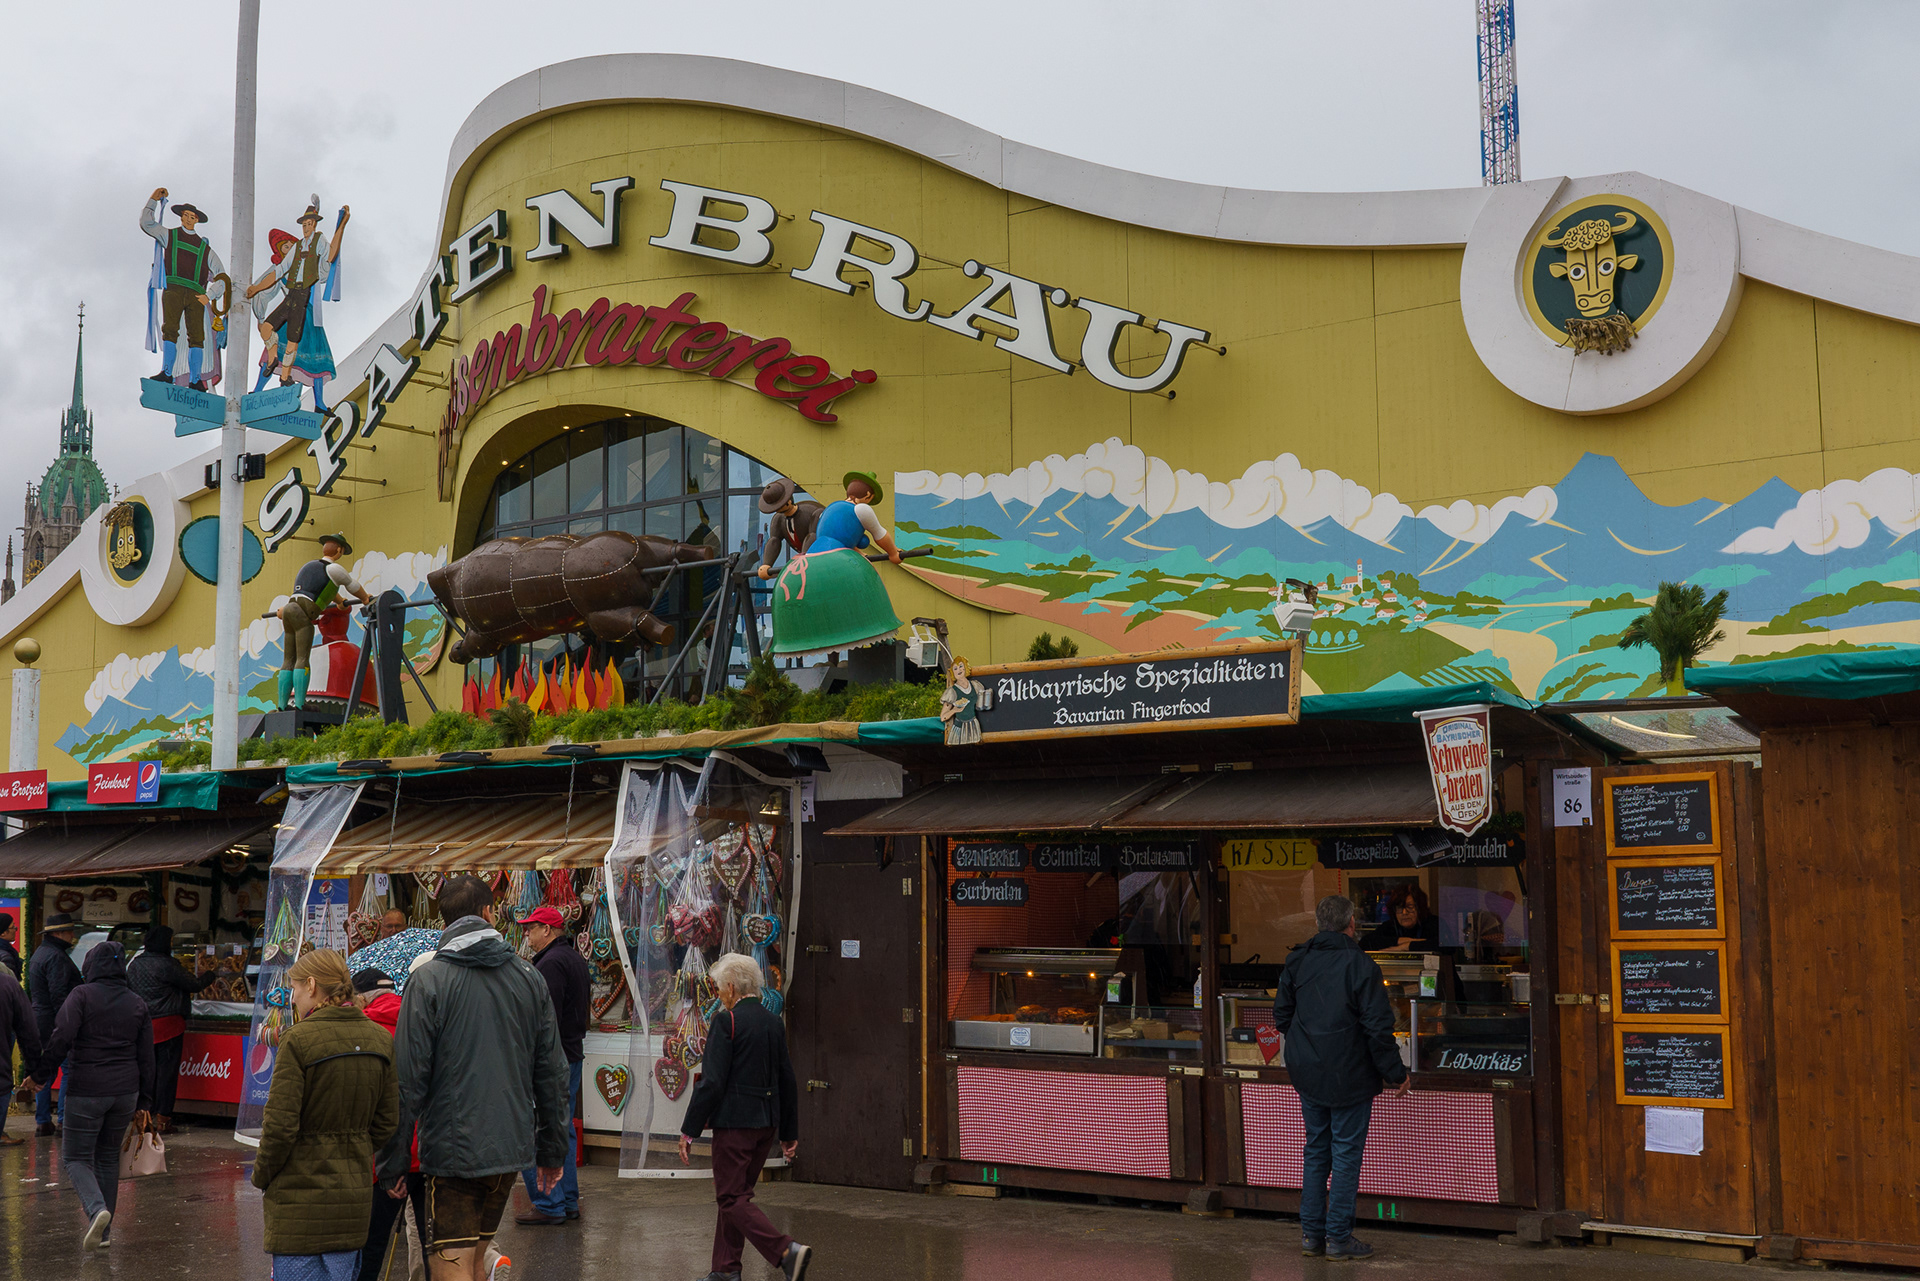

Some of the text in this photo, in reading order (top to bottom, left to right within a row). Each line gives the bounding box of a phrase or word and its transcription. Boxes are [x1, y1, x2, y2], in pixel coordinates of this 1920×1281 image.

[257, 175, 1211, 554] SPATENBRÄU
[166, 388, 209, 409] Vilshofen
[997, 658, 1285, 703] Altbayrische Spezialitäten
[1053, 698, 1211, 725] Bavarian Fingerfood
[1442, 722, 1473, 734] ORIGINAL
[1431, 739, 1488, 775] Schweine
[12, 780, 44, 801] Brotzeit
[94, 773, 131, 793] Feinkost
[1450, 801, 1482, 812] AUS DEM
[1564, 798, 1582, 814] 86
[1039, 845, 1102, 867] Schnitzel
[1231, 840, 1308, 868] KASSE
[1452, 837, 1508, 864] pfnudeln
[378, 876, 387, 887] 90
[956, 880, 1022, 902] Surbraten
[179, 1052, 231, 1079] einkost
[252, 1090, 269, 1100] peps
[982, 1168, 999, 1182] 14
